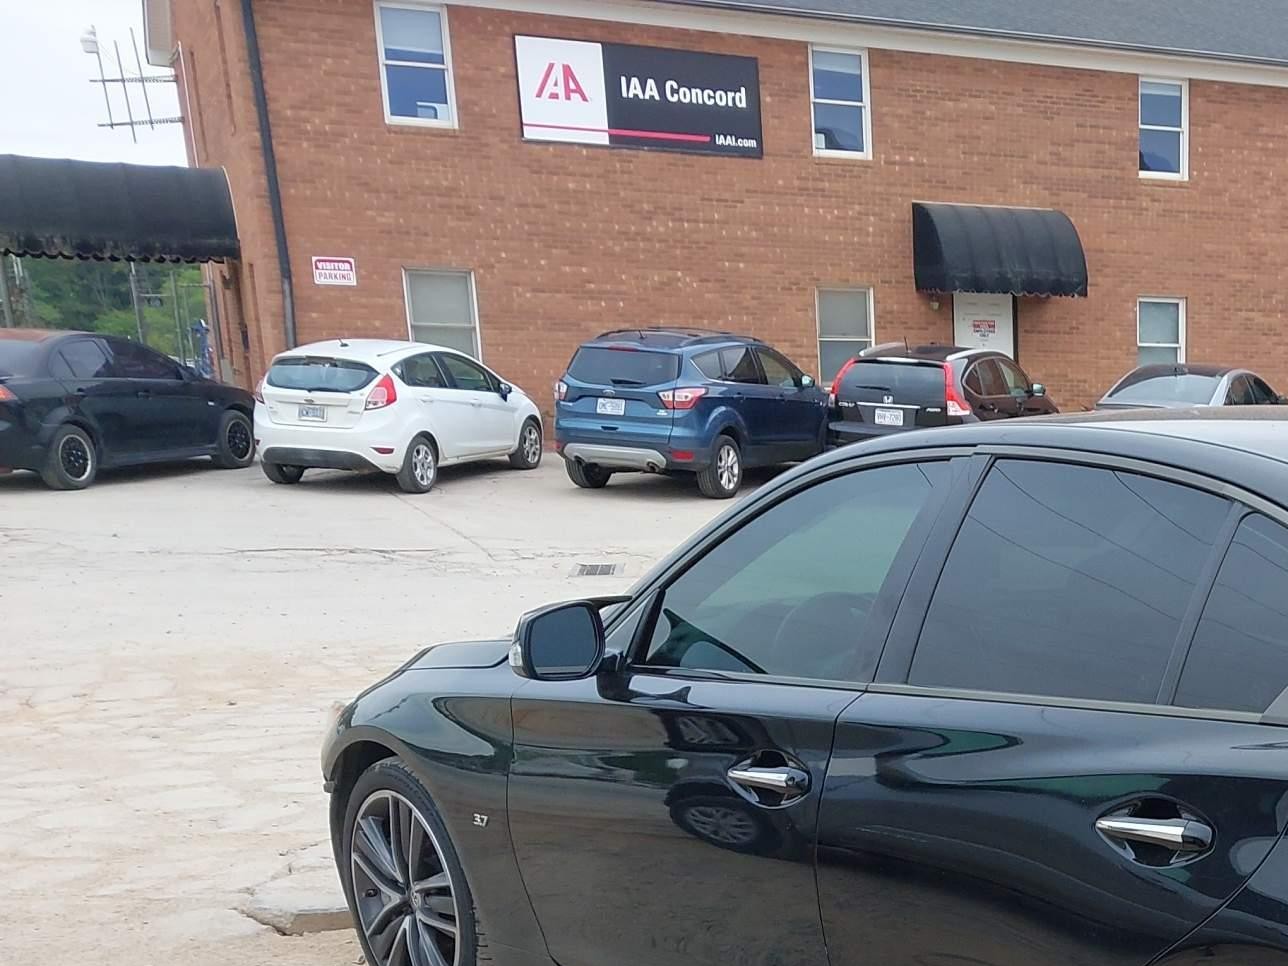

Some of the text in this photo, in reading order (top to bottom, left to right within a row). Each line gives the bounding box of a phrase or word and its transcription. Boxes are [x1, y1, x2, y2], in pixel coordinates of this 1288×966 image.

[620, 75, 748, 109] IAA Concord
[715, 133, 757, 148] IAAI.com
[316, 261, 351, 271] VISITOR
[317, 271, 352, 282] PARKING
